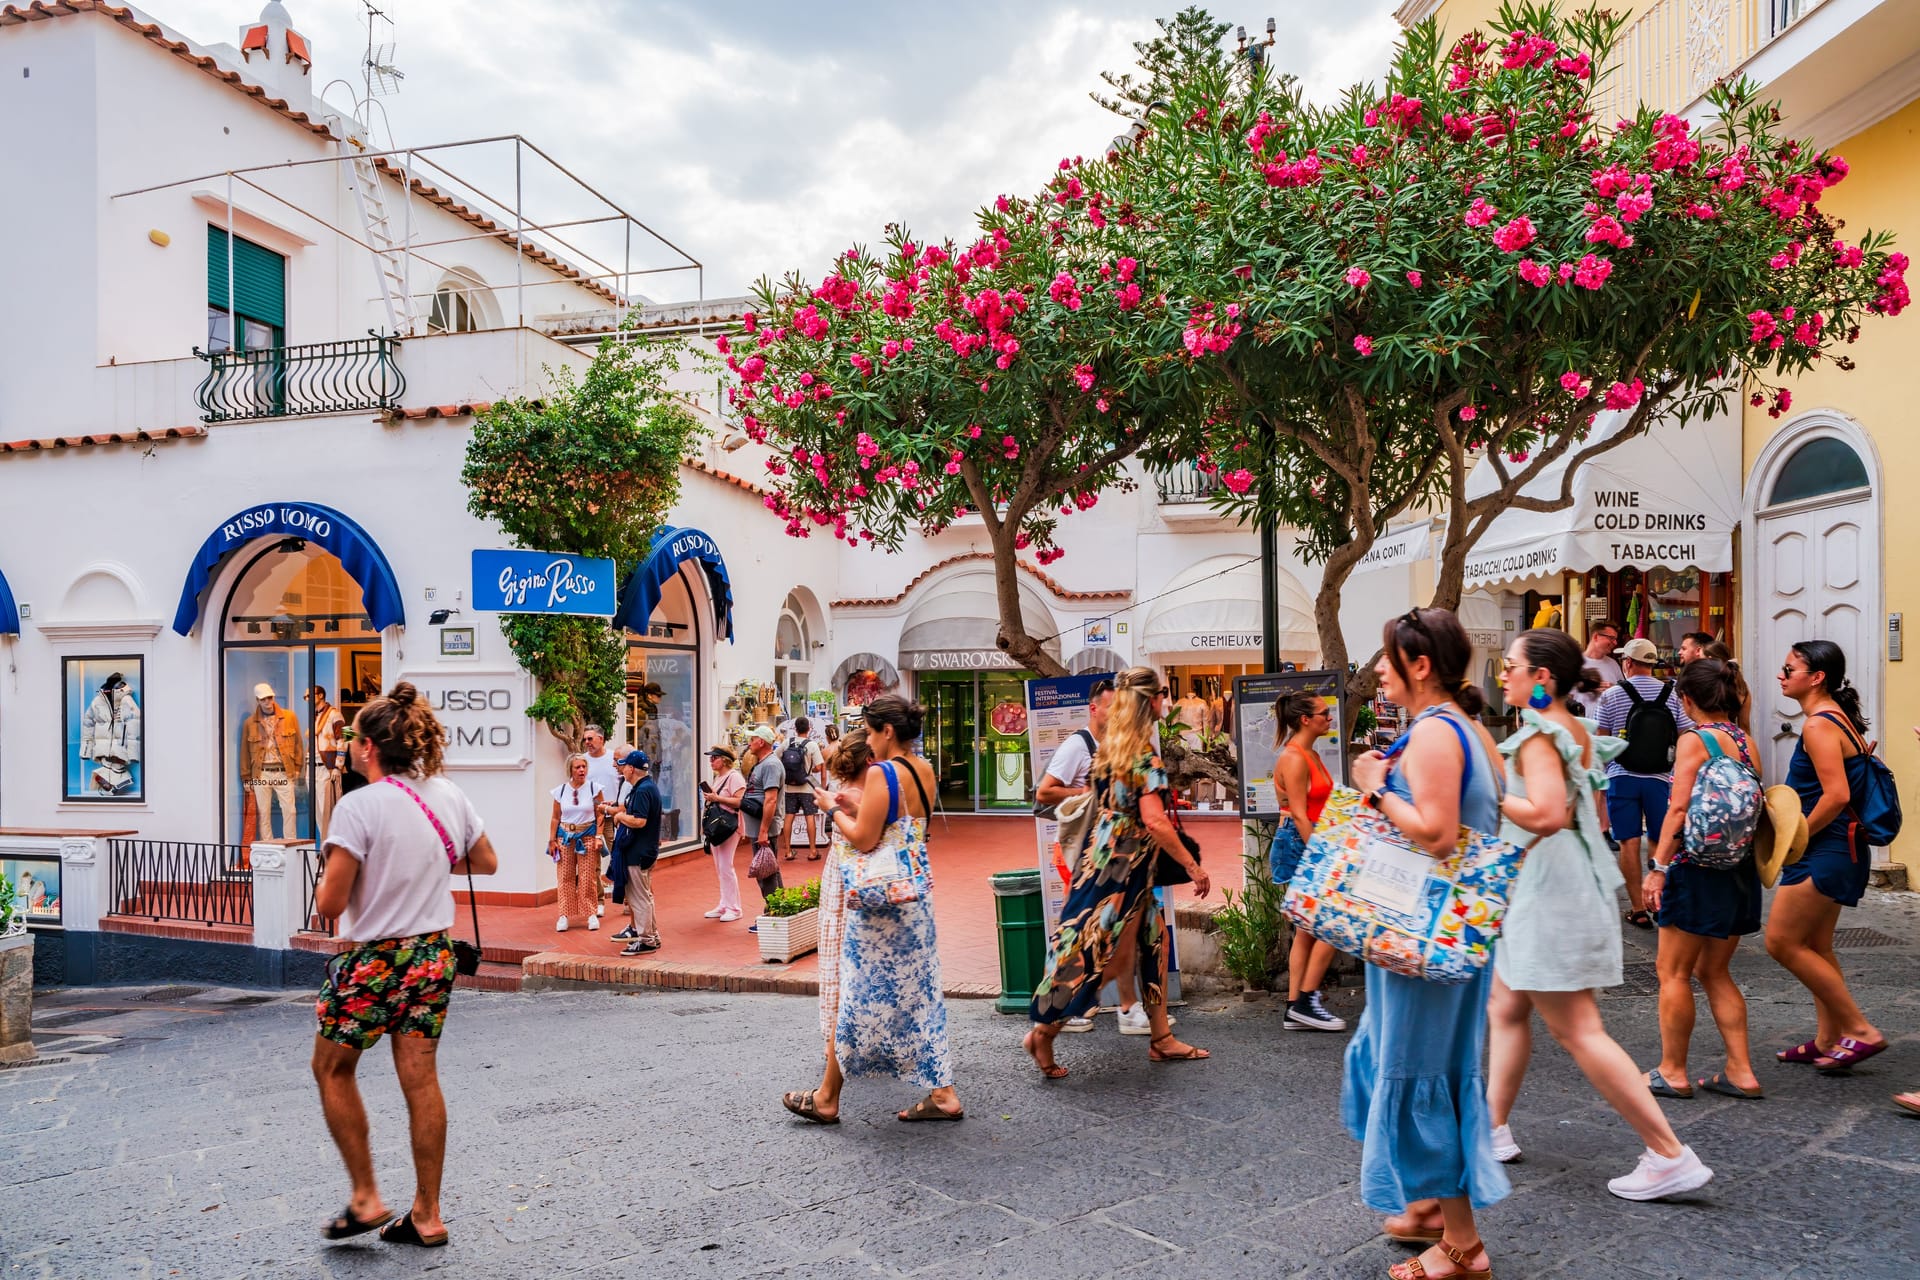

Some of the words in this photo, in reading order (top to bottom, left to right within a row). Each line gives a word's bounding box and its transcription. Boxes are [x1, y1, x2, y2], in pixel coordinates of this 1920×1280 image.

[1594, 491, 1640, 508] WINE
[280, 508, 331, 537] UOMO
[1594, 513, 1640, 530] COLD
[1645, 514, 1706, 531] DRINKS
[1358, 549, 1381, 566] IANA
[1382, 542, 1406, 560] CONTI
[1611, 544, 1696, 560] TABACCHI
[1465, 559, 1502, 579] TABACCHI
[1502, 554, 1525, 572] COLD
[1526, 547, 1558, 568] DRINKS
[499, 566, 547, 606] Gigino
[545, 559, 595, 607] Russo
[1191, 635, 1252, 647] CREMIEUX
[425, 690, 511, 711] USSO
